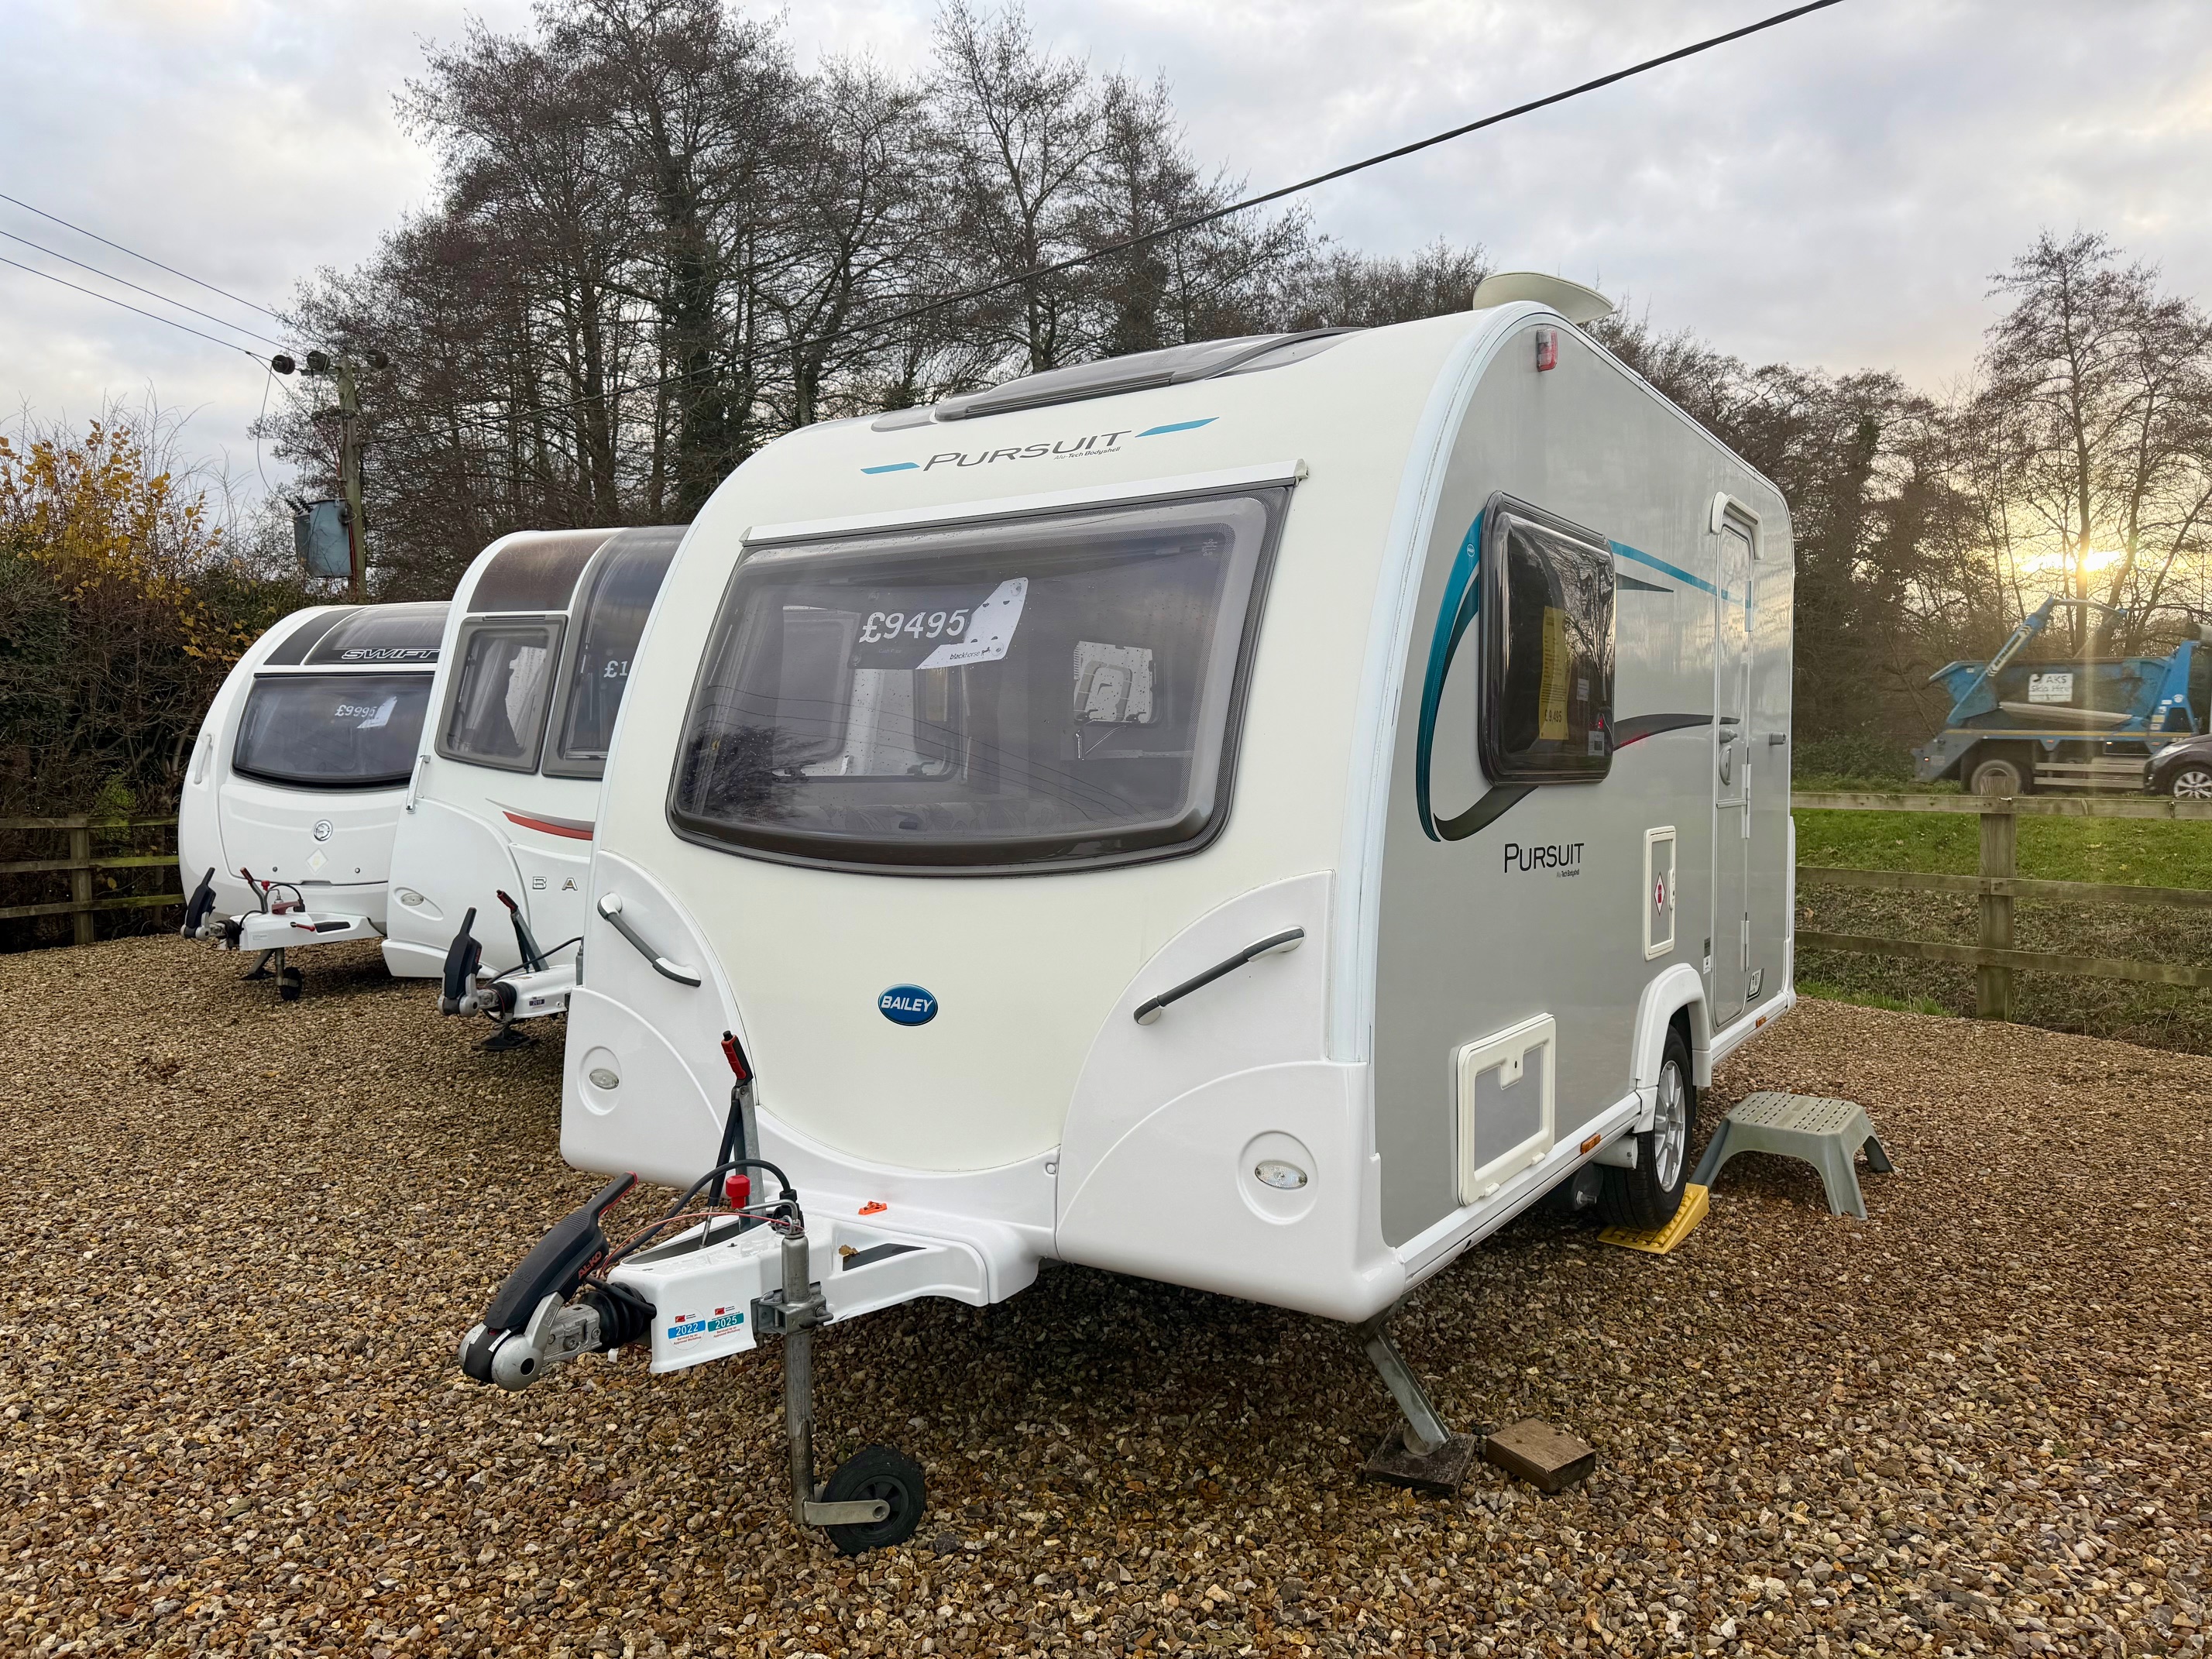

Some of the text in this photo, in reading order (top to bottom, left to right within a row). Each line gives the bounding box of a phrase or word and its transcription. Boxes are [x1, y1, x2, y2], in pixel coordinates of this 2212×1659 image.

[922, 430, 1132, 472] PURSUIT
[1084, 446, 1121, 456] Bodyshell
[858, 608, 970, 644] £9495
[341, 648, 441, 660] SWIFT
[1504, 843, 1585, 874] PURSUIT
[881, 995, 933, 1012] BAILEY
[578, 1250, 603, 1280] AL-KO
[675, 1323, 699, 1336] 2022
[715, 1315, 737, 1330] 2025
